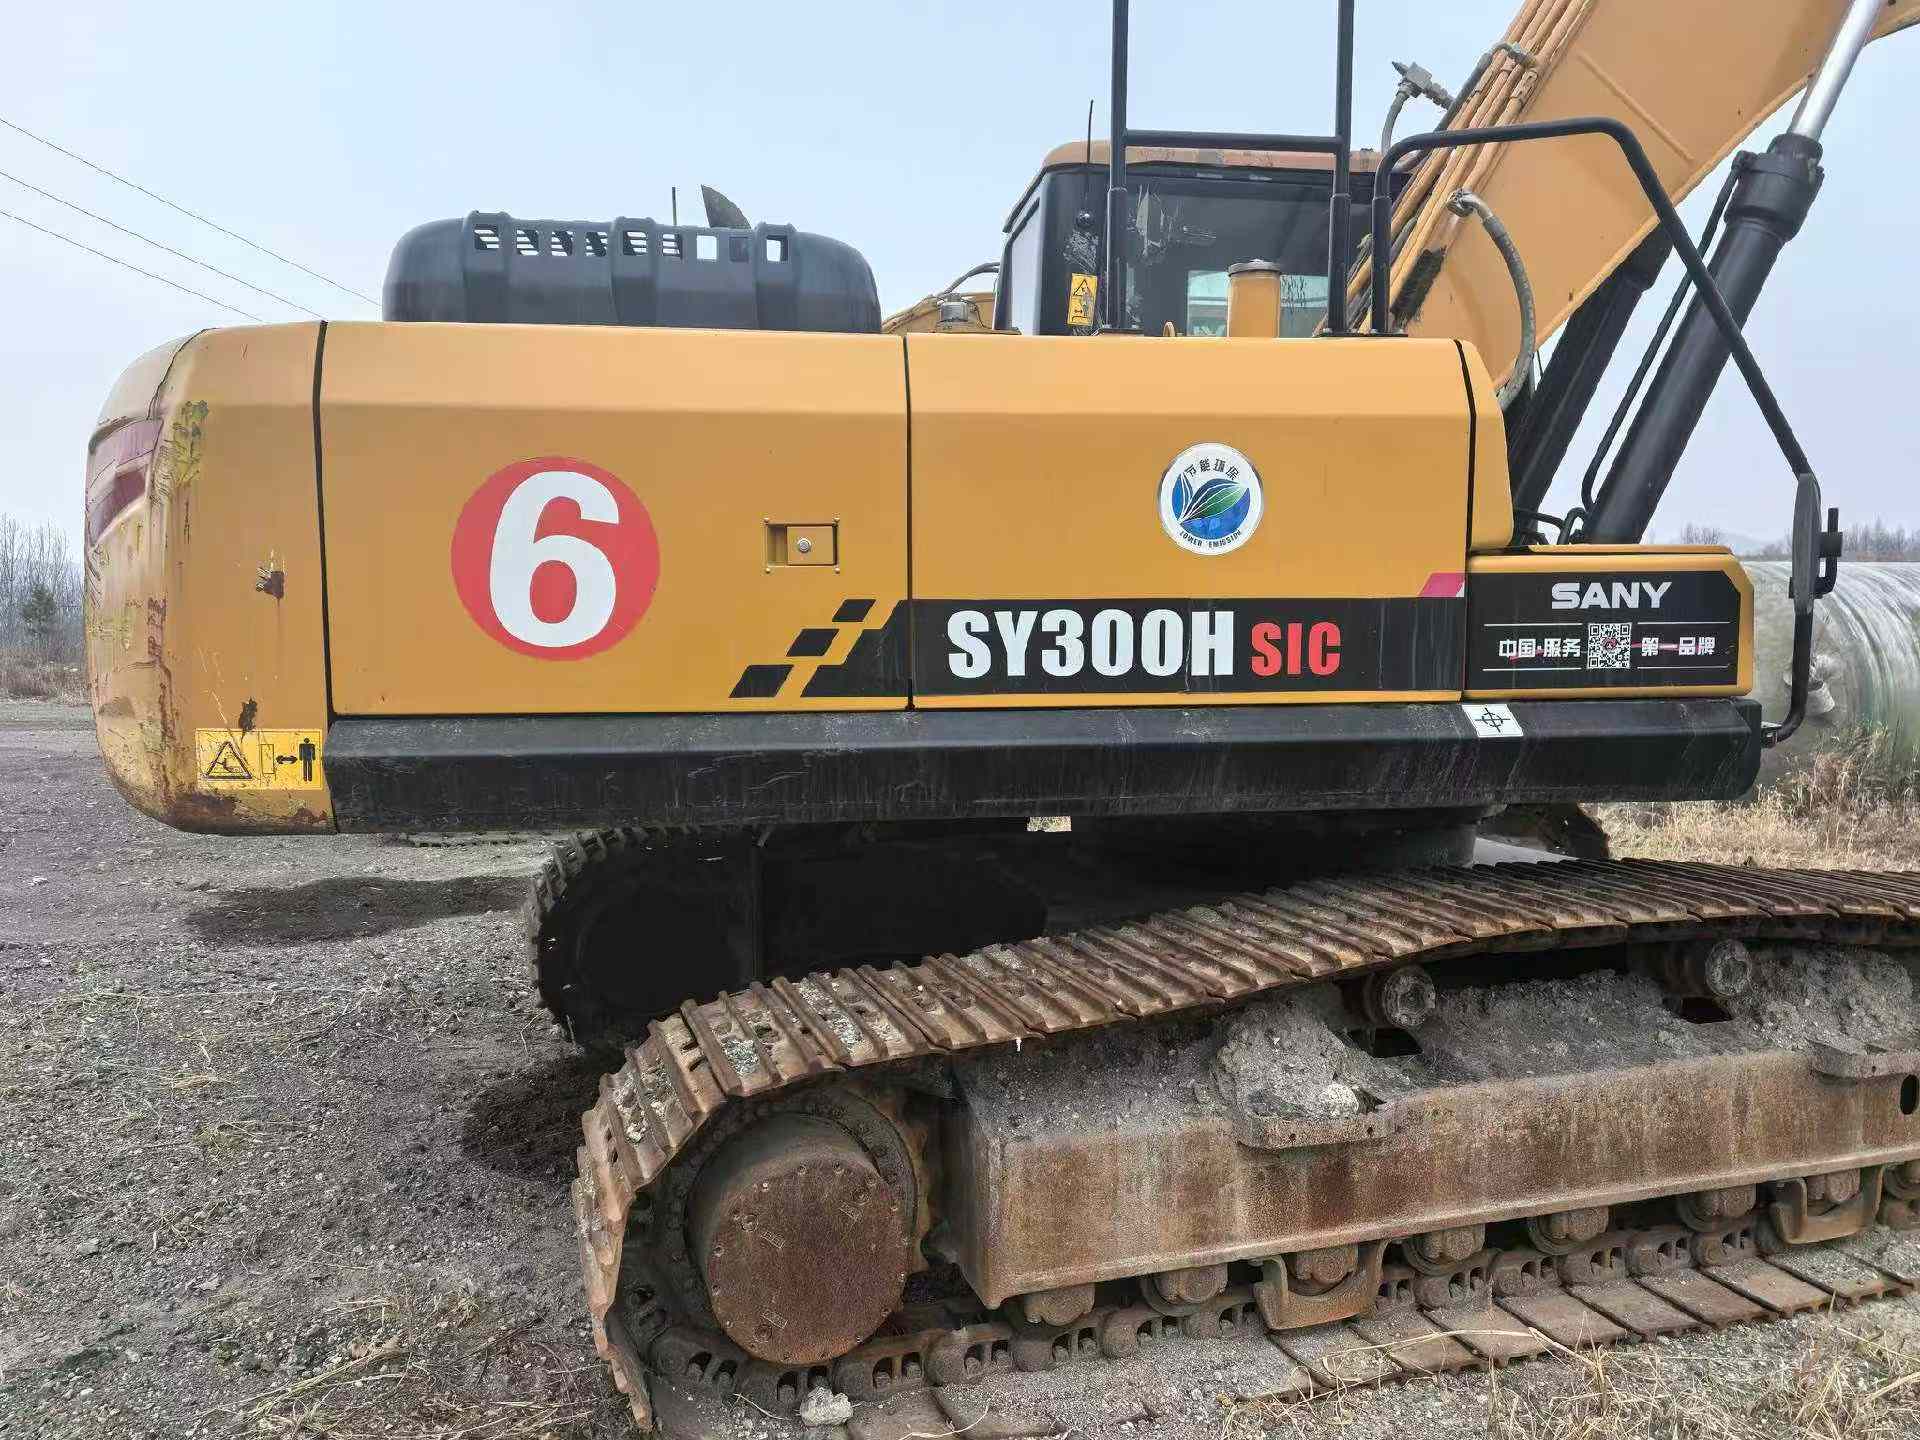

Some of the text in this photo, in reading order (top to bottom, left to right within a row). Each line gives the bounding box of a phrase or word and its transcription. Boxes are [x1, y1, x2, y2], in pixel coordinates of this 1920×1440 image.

[1184, 458, 1239, 480] 节能环保
[1179, 531, 1202, 547] LOWER
[490, 470, 619, 647] 6
[1551, 581, 1672, 609] SANY
[946, 609, 1341, 678] SY300H SIC
[1641, 636, 1715, 656] 第一品牌
